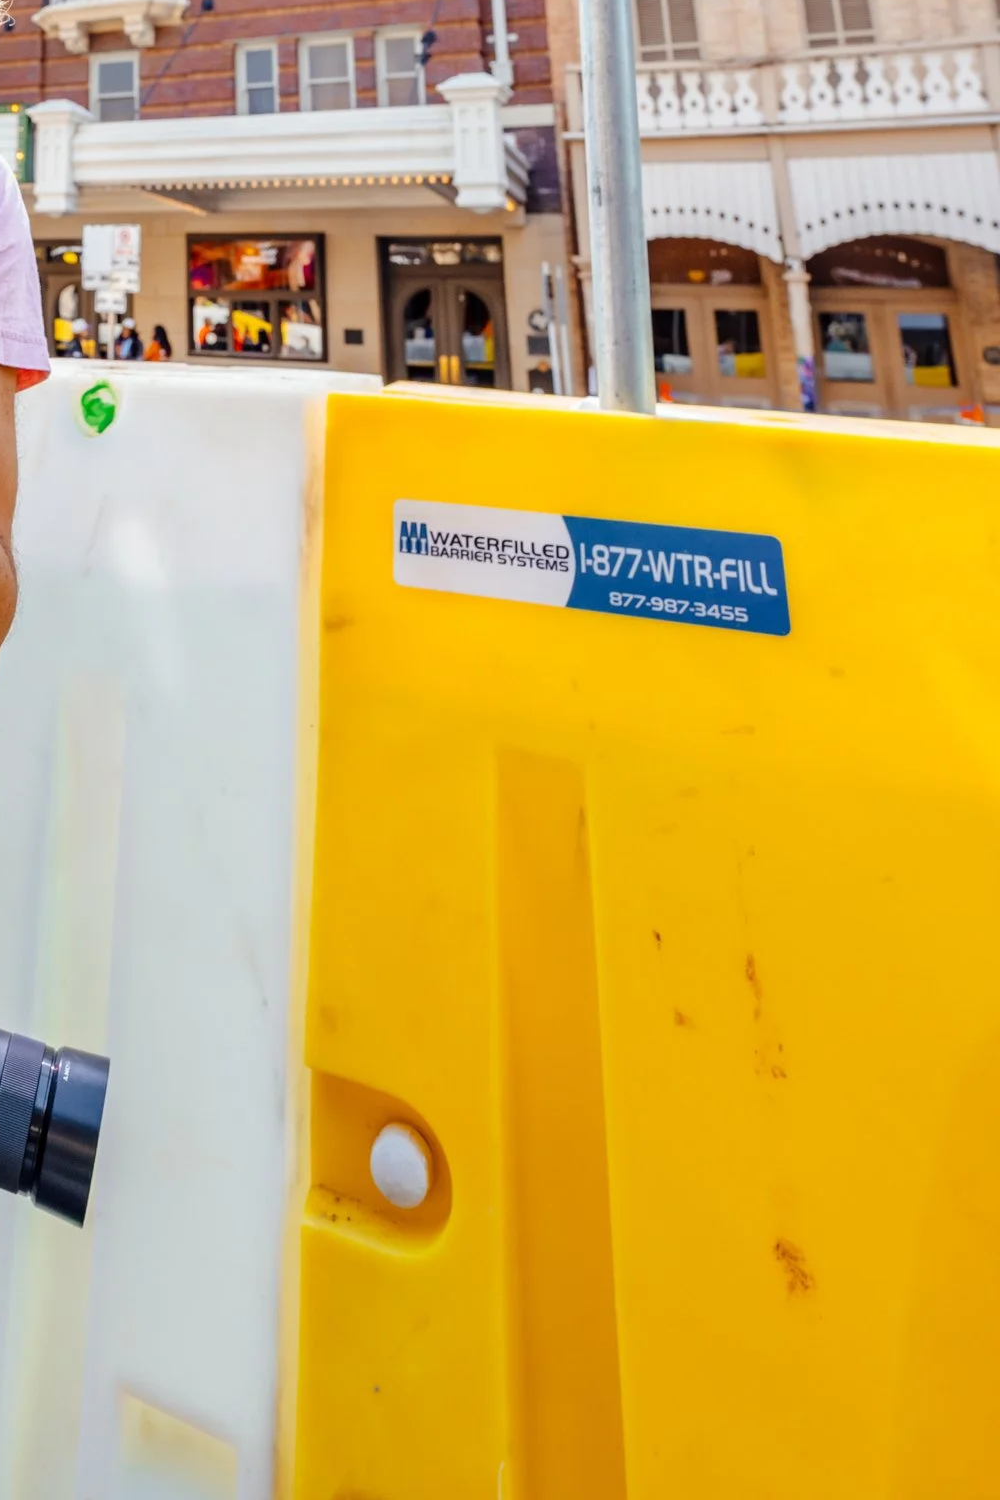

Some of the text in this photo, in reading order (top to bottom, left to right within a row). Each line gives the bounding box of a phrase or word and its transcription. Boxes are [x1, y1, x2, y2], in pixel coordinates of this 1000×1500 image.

[429, 530, 570, 560] WATERFILLED
[429, 545, 569, 572] BARRIER SYSTEMS
[608, 591, 749, 623] 877-987-3455
